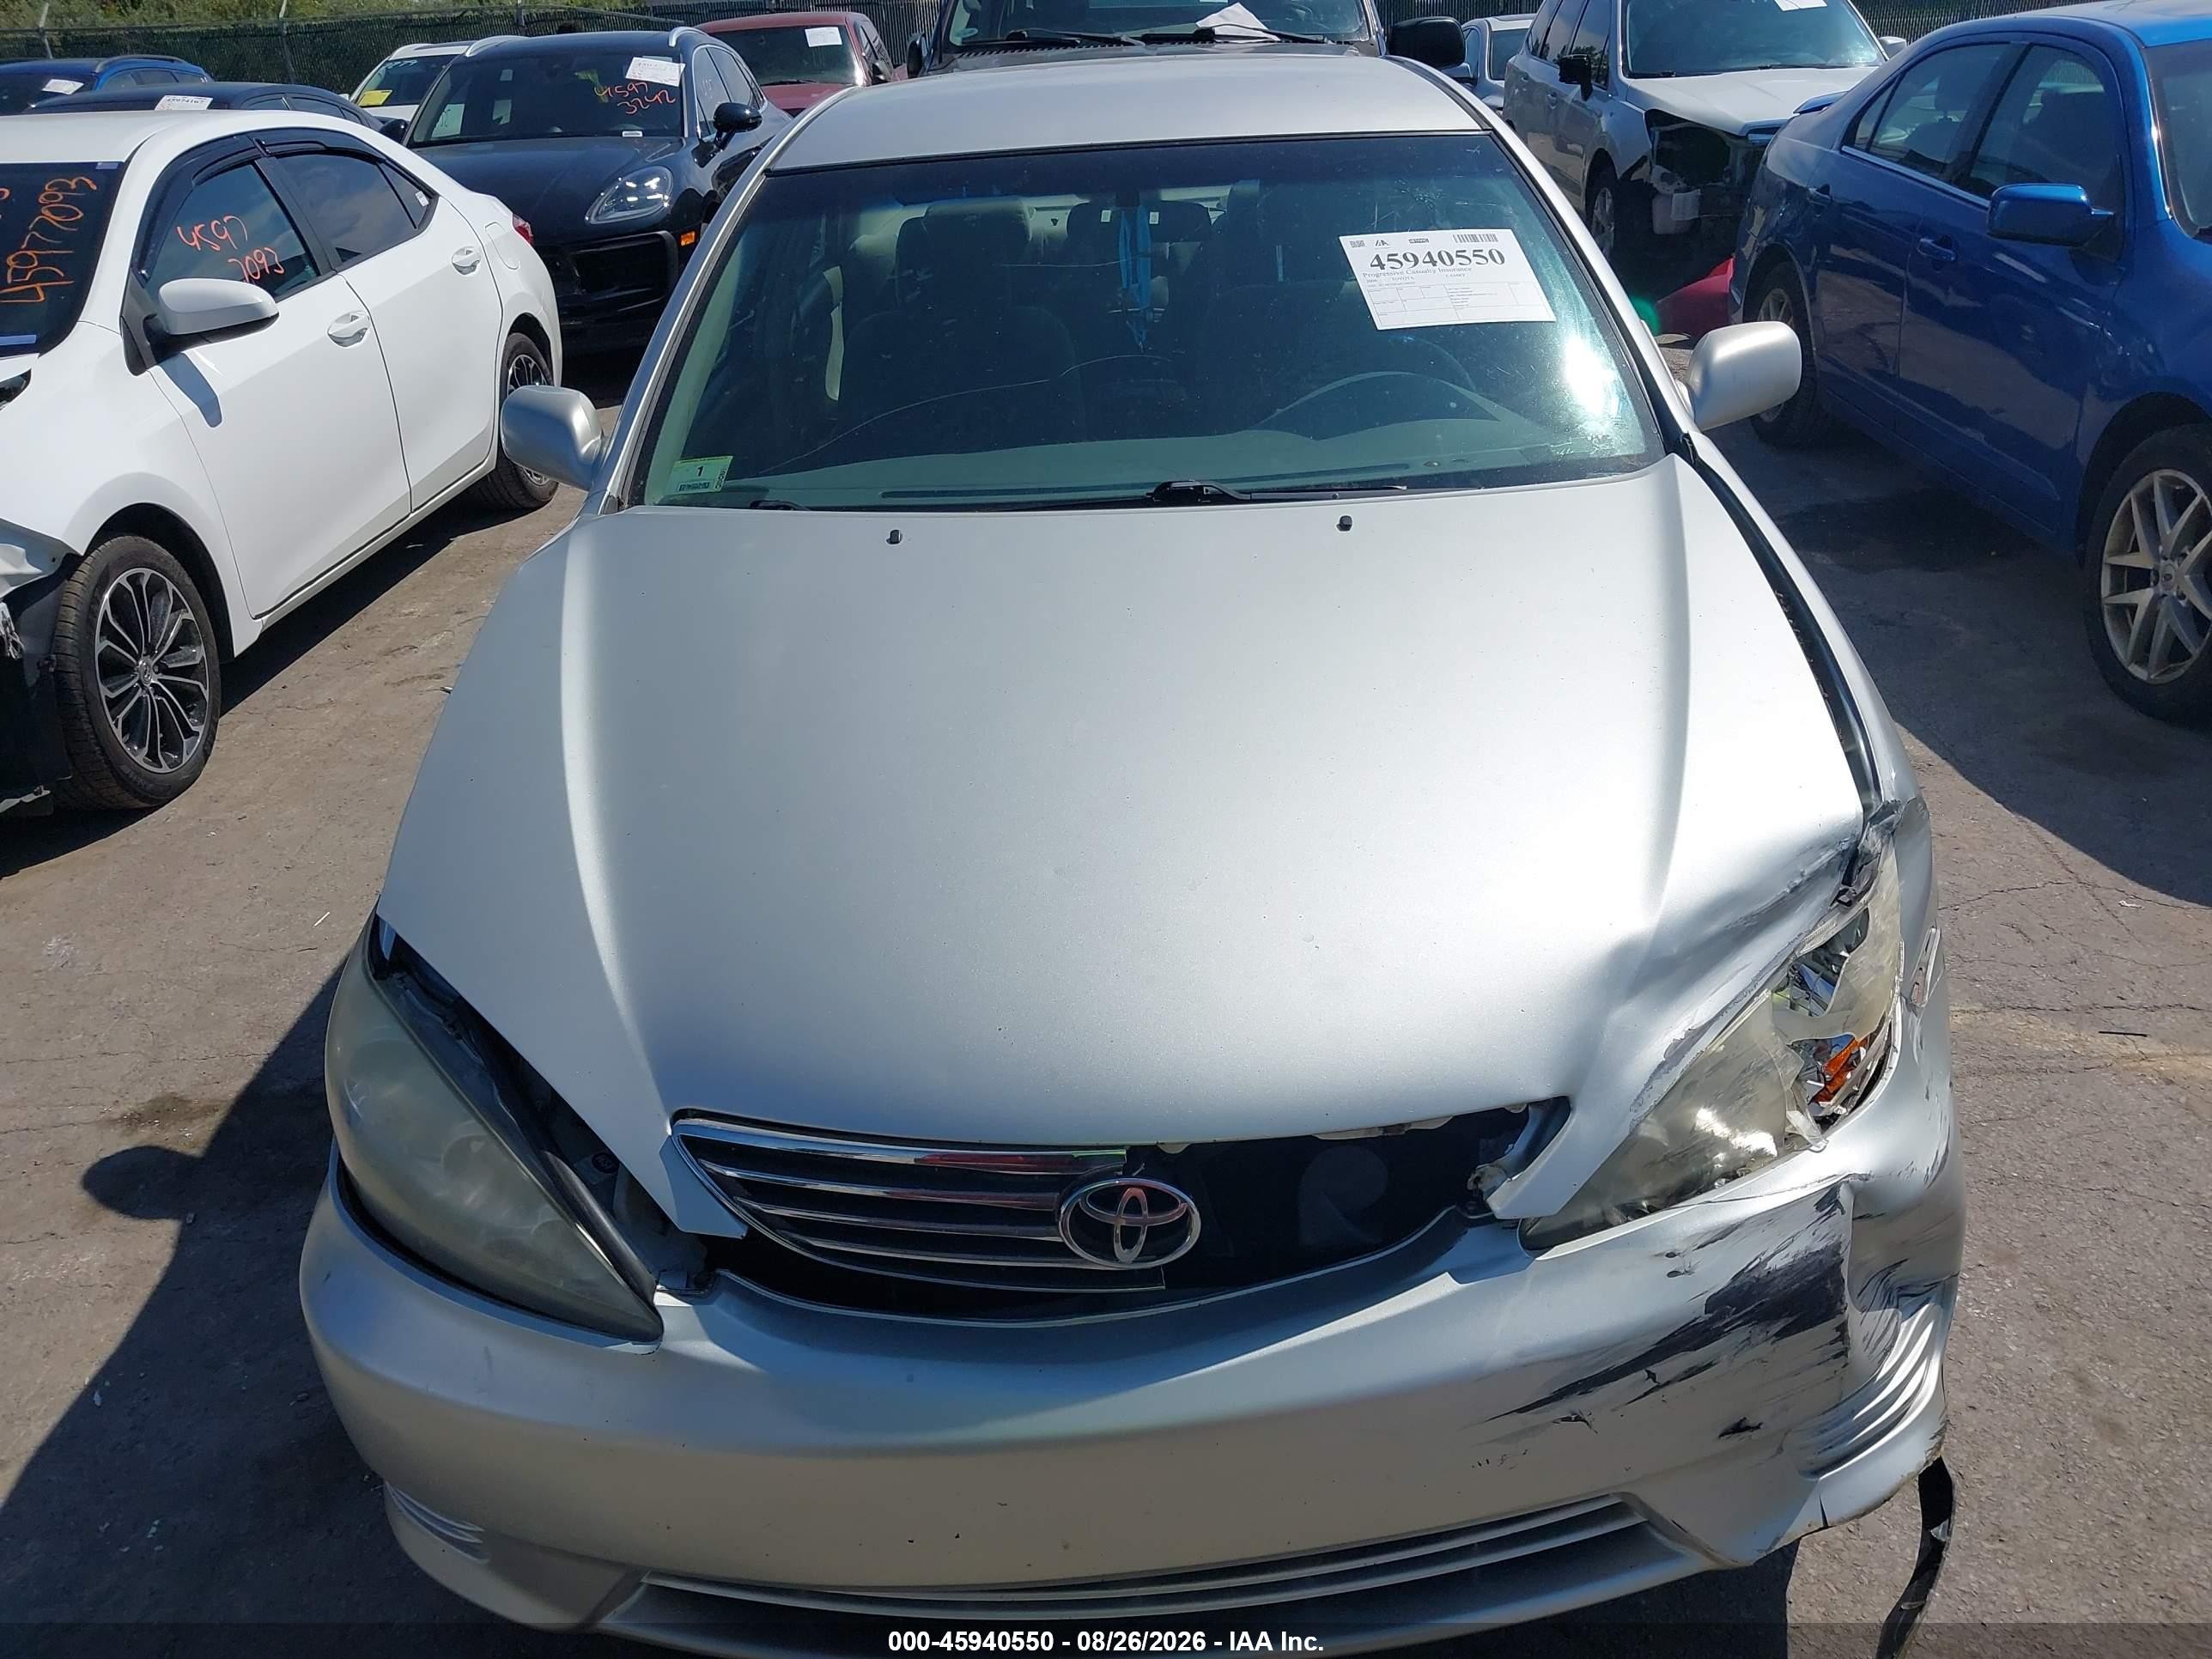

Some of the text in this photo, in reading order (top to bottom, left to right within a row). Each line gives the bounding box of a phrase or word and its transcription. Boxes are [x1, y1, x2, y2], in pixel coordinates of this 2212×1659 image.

[593, 82, 648, 98] 4597
[617, 89, 677, 115] 3242
[0, 176, 98, 303] 45977093
[177, 215, 248, 251] 4597
[227, 247, 285, 283] 7093
[1370, 248, 1505, 270] 45940550
[1362, 270, 1404, 279] Progressive
[1406, 268, 1437, 276] Casualty
[696, 465, 704, 477] 1
